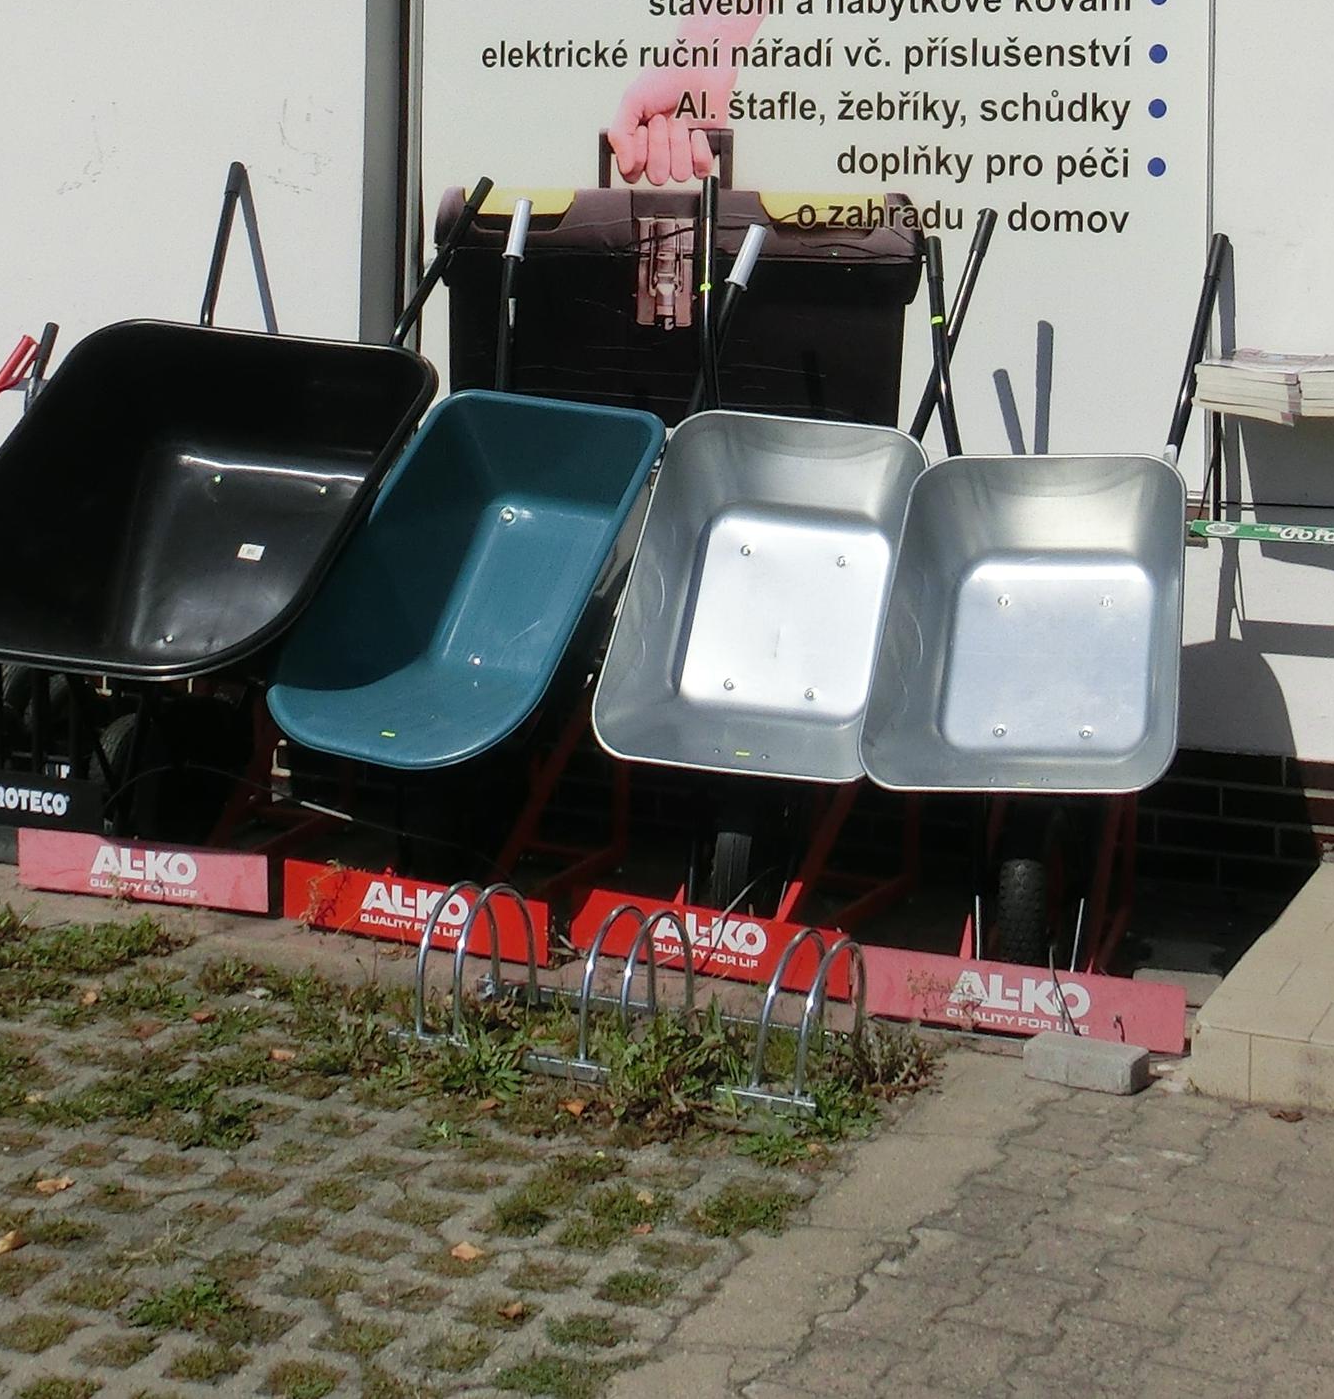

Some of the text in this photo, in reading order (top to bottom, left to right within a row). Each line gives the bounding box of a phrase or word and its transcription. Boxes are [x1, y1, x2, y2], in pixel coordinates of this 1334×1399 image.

[481, 35, 1133, 75] elektrické ruční nářadí vč. příslušenství
[675, 90, 1132, 131] Al. štafle, žebříky, schůdky
[836, 145, 1130, 185] doplňky pro péči
[796, 204, 817, 228] o
[827, 199, 964, 231] zahradu
[1007, 202, 1130, 234] domov
[90, 845, 199, 886] AL-KO
[360, 913, 414, 930] QUALITY
[652, 912, 768, 956] AL-KO
[947, 970, 1091, 1019] AL-KO
[1017, 1016, 1052, 1030] FOR
